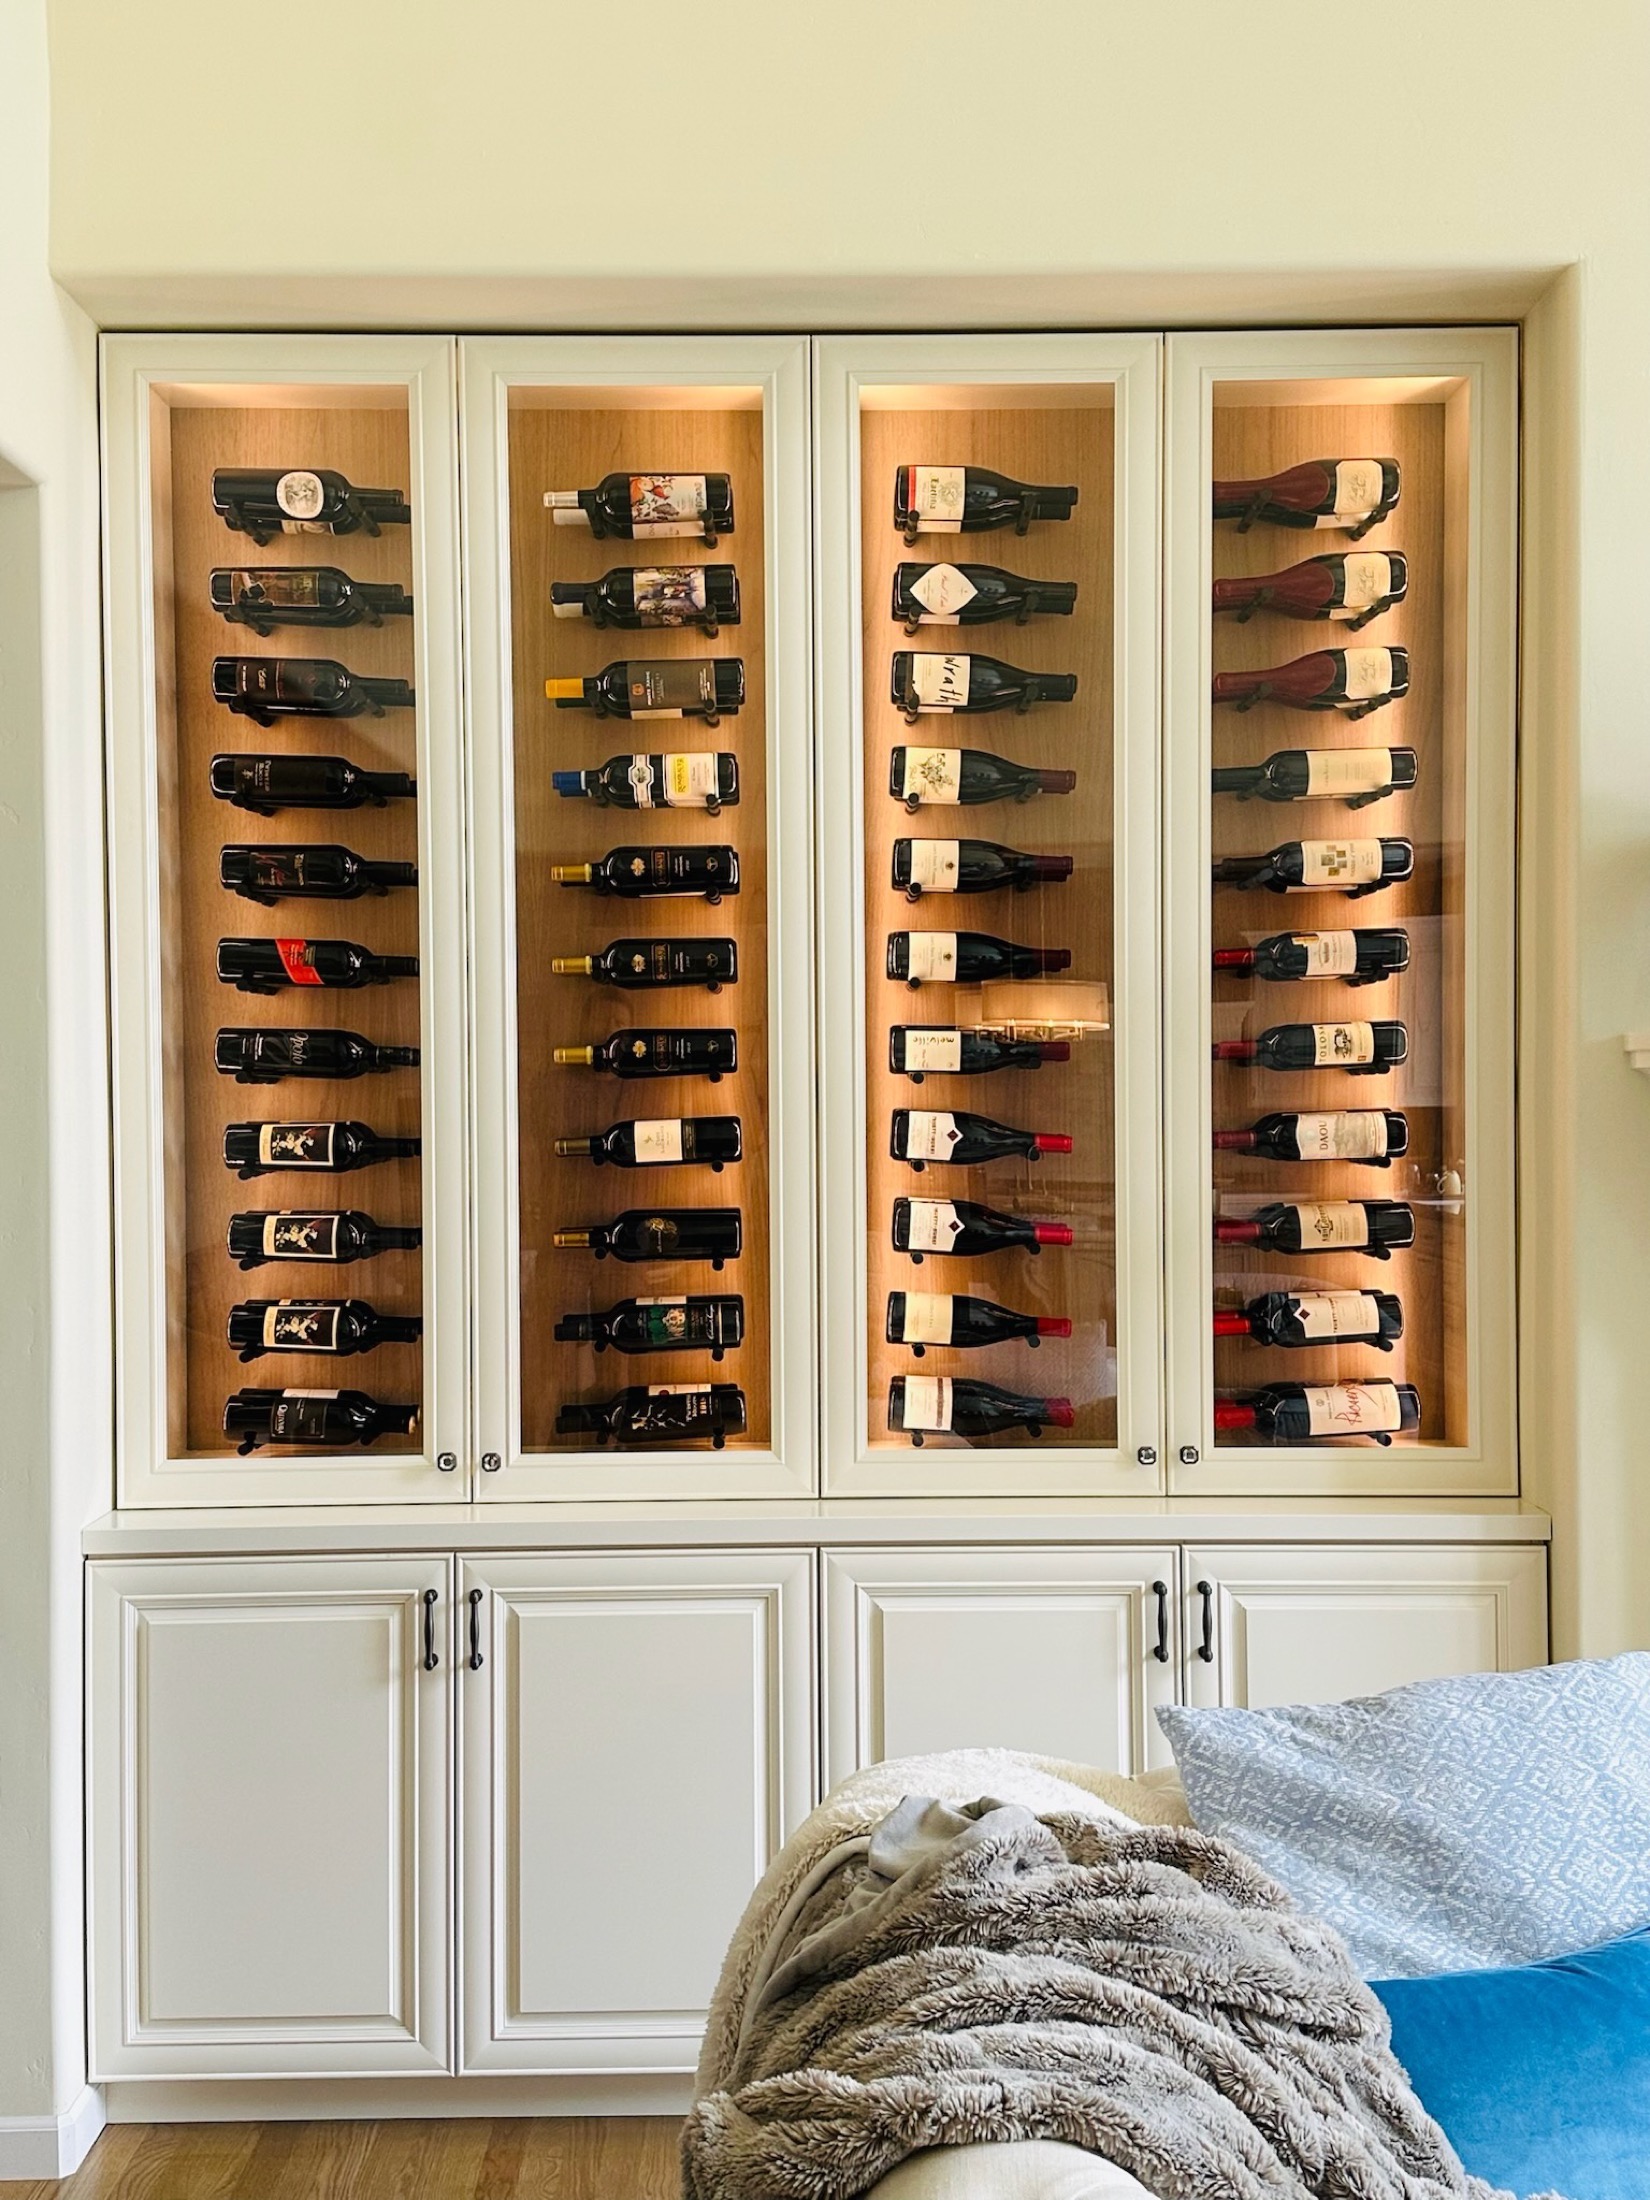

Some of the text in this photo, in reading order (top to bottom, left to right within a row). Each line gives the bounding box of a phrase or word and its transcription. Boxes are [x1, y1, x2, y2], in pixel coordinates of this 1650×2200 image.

[934, 656, 962, 703] wrath
[288, 1031, 310, 1065] Opolo
[912, 1036, 955, 1046] melville
[1318, 1026, 1327, 1063] TOLOSA
[1318, 1120, 1329, 1150] DAOU
